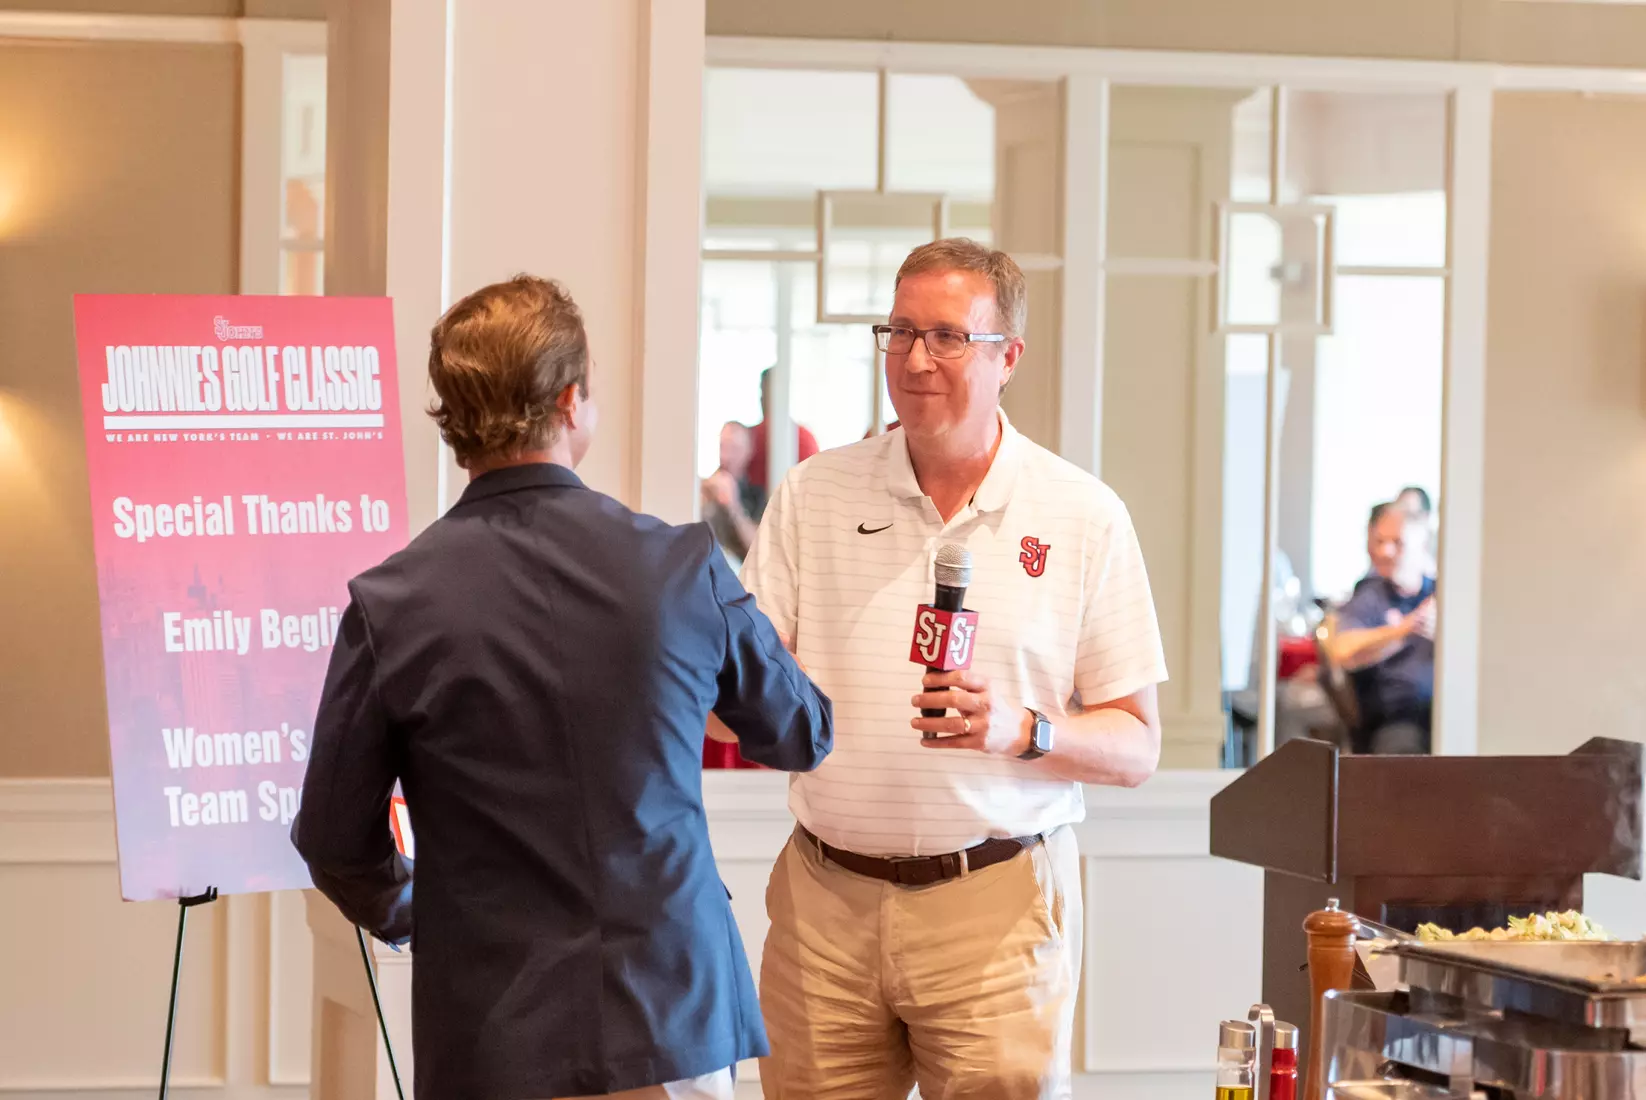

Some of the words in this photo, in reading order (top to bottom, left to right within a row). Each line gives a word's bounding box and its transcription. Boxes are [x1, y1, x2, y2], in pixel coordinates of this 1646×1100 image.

[101, 345, 221, 412] JOHNNIES
[221, 345, 280, 411] GOLF
[282, 345, 382, 411] CLASSIC
[105, 433, 123, 442] WE
[127, 433, 149, 442] ARE
[153, 433, 178, 442] NEW
[183, 432, 225, 441] YORK'S
[229, 432, 260, 441] TEAM
[276, 431, 293, 440] WE
[297, 431, 318, 440] ARE
[322, 431, 339, 440] ST.
[343, 431, 383, 440] JOHN'S
[112, 496, 235, 543] Special
[242, 494, 353, 535] Thanks
[359, 494, 391, 532] to
[163, 610, 251, 655] Emily
[260, 606, 343, 653] Begli
[162, 723, 307, 769] Women's
[163, 786, 249, 827] Team
[258, 780, 303, 826] Sp
